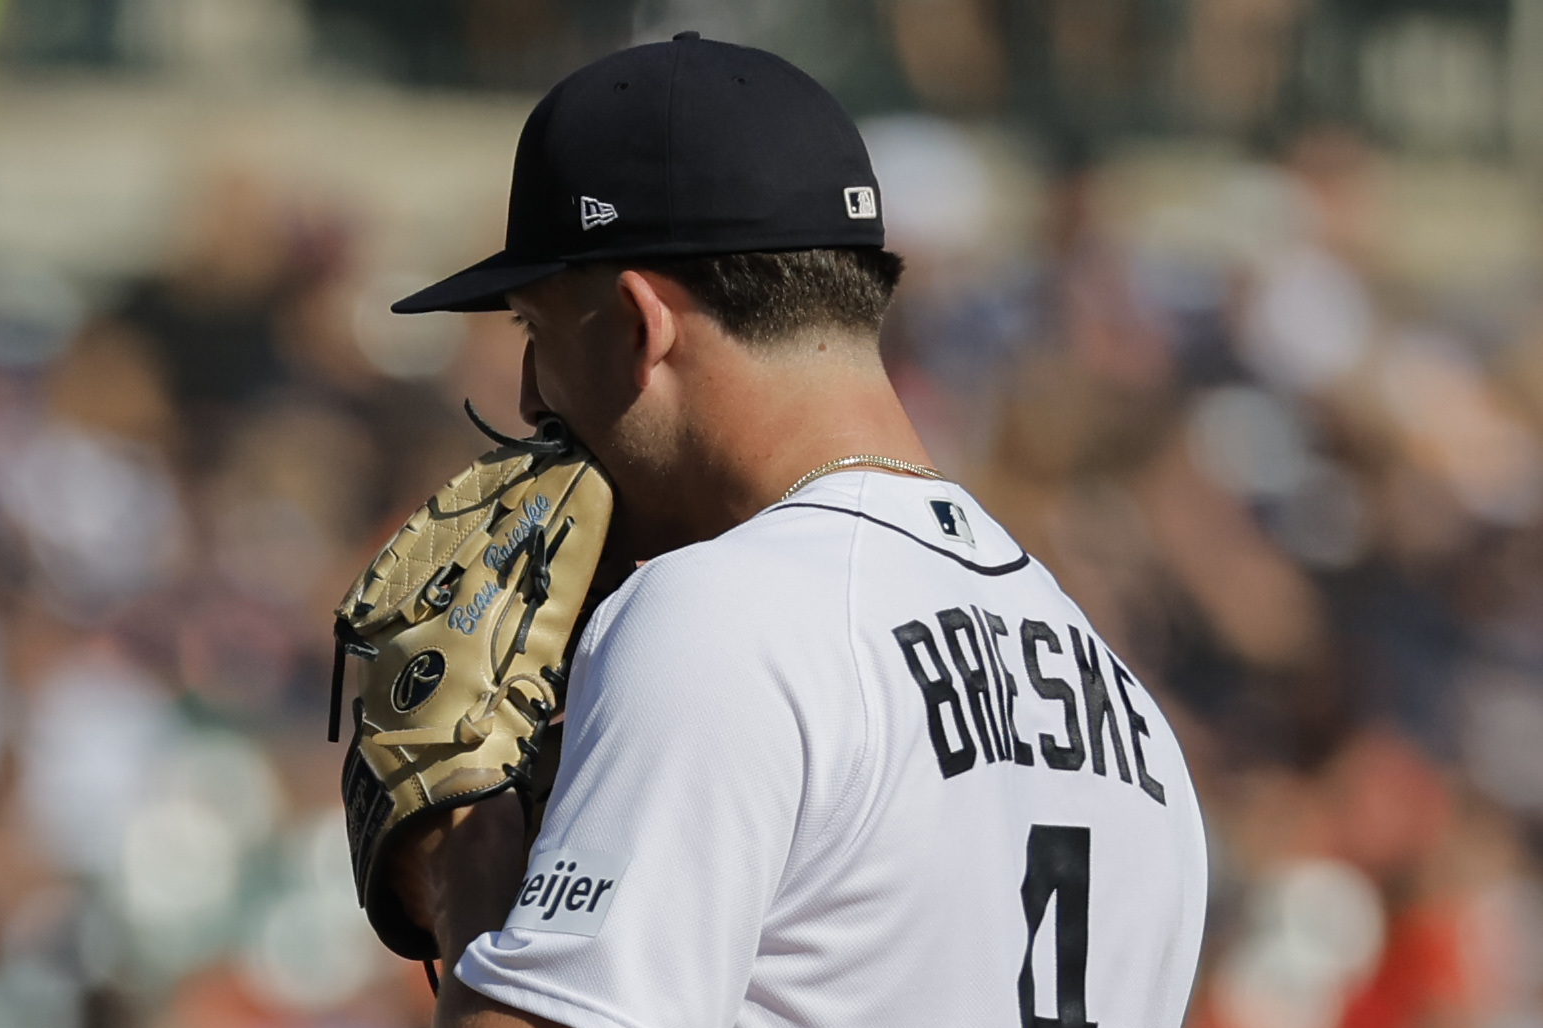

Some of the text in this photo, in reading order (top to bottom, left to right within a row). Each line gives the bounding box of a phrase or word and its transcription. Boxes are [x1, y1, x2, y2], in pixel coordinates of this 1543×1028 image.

[447, 578, 501, 635] Beau
[891, 604, 1167, 807] BRIESKE
[511, 860, 615, 921] eijer
